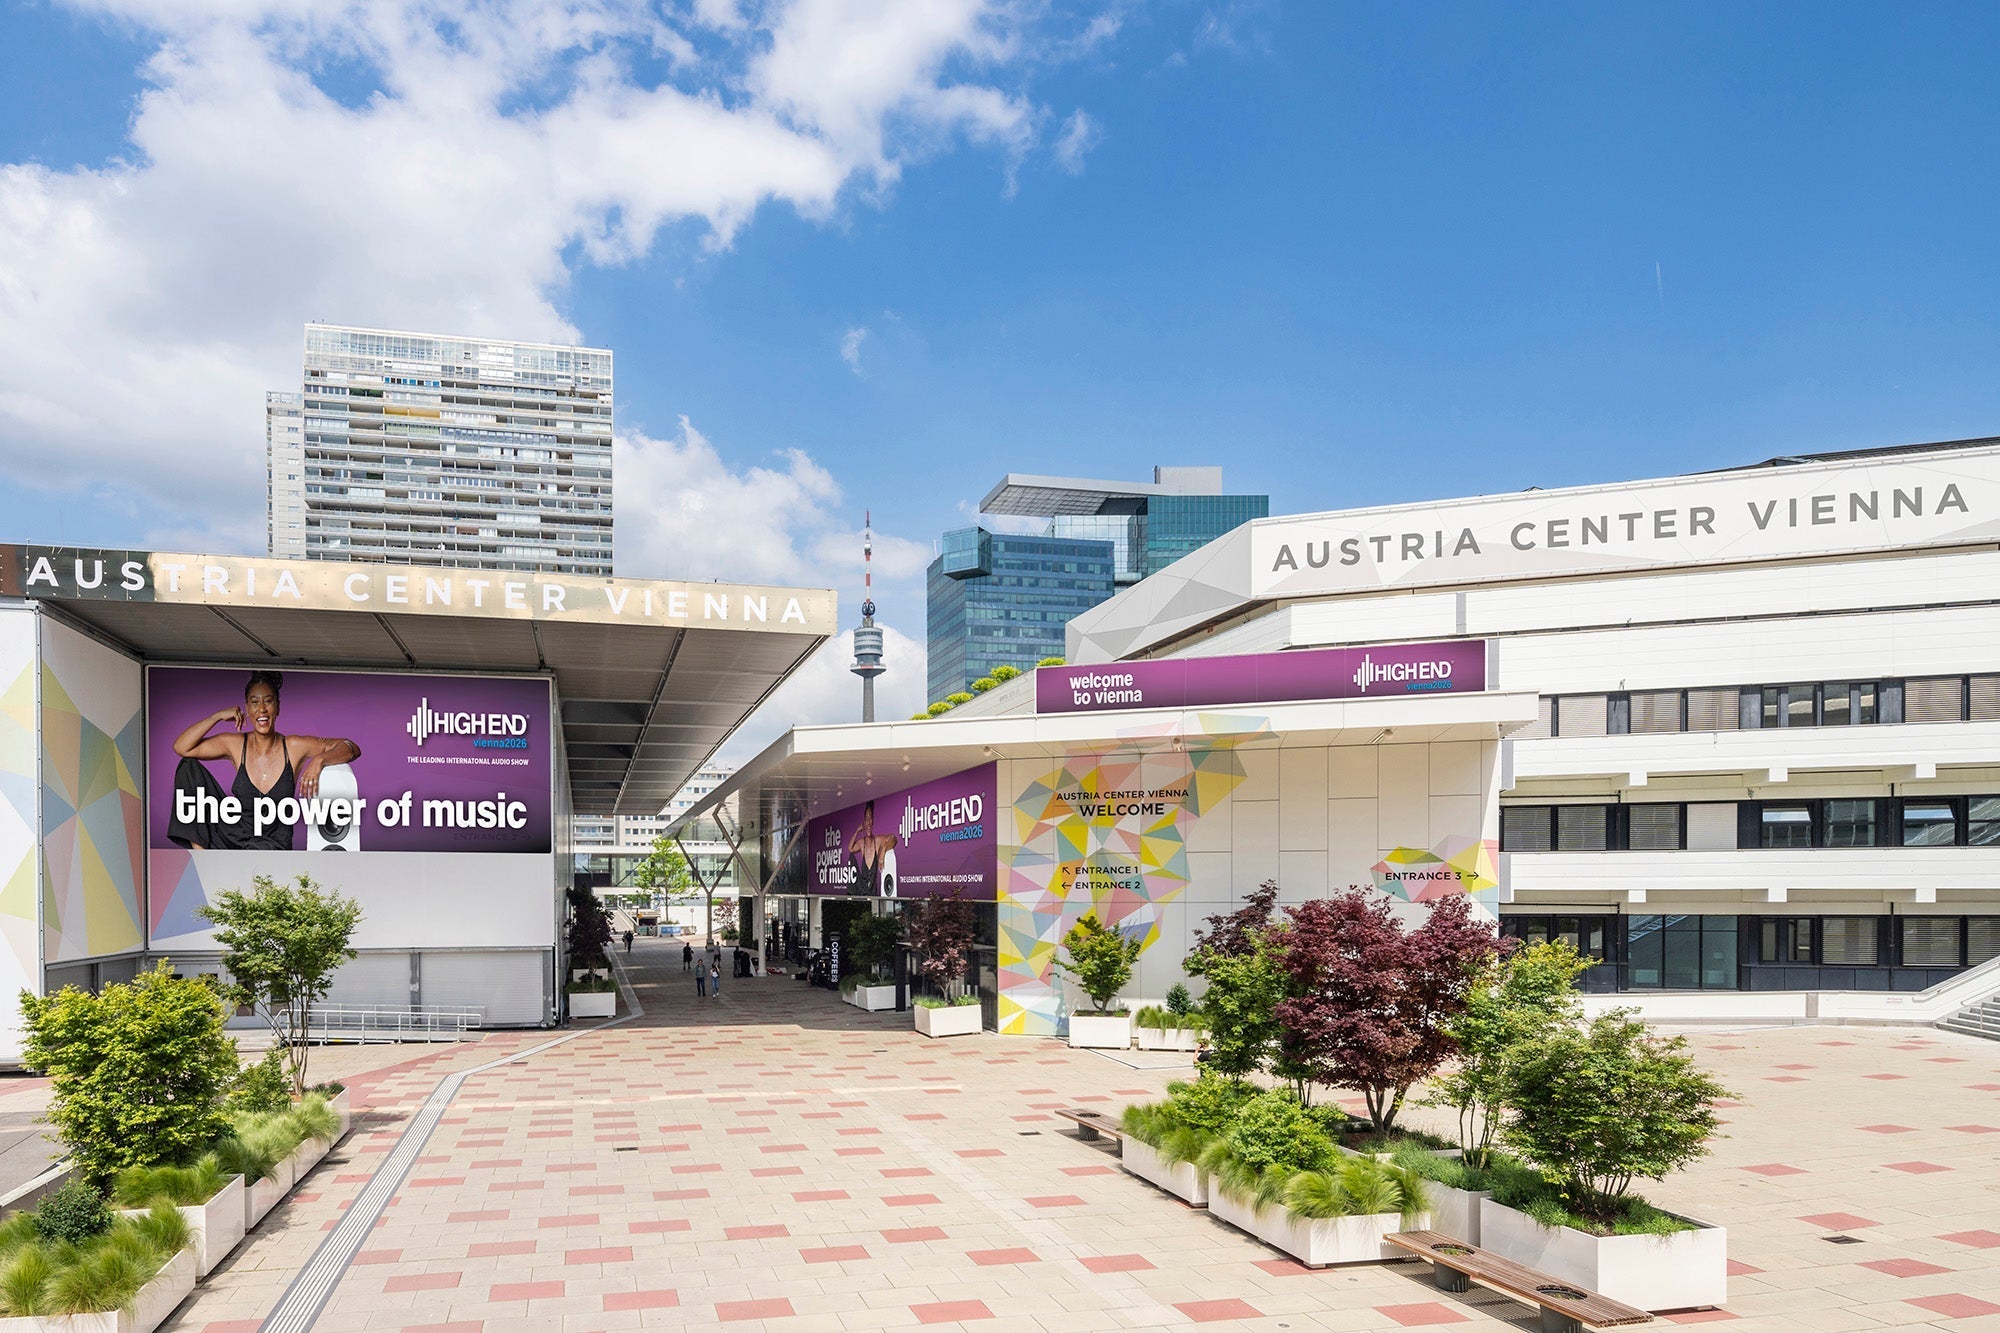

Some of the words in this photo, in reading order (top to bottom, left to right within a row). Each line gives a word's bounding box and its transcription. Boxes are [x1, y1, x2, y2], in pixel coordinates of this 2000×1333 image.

[1271, 526, 1481, 573] AUSTRIA
[1510, 506, 1715, 551] CENTER
[1747, 483, 1969, 530] VIENNA
[26, 556, 301, 599] AUSTRIA
[344, 573, 566, 611] CENTER
[604, 587, 807, 624] VIENNA
[1069, 672, 1133, 690] welcome
[1406, 680, 1452, 690] vienna2026
[1073, 690, 1091, 705] to
[1095, 688, 1142, 704] vienna
[473, 738, 528, 749] vienna2026
[419, 756, 445, 764] LEADING
[510, 758, 529, 766] SHOW
[1056, 792, 1100, 801] AUSTRIA
[1103, 790, 1145, 799] CENTER
[1147, 789, 1189, 798] VIENNA
[175, 787, 242, 825] the
[253, 797, 367, 837] power
[377, 790, 412, 827] of
[422, 792, 528, 829] music
[1079, 803, 1165, 816] WELCOME
[825, 826, 841, 848] the
[940, 824, 983, 842] vienna2026
[816, 848, 842, 873] power
[819, 863, 828, 884] of
[829, 860, 857, 884] music
[968, 874, 983, 882] SHOW
[1075, 866, 1131, 874] ENTRANCE
[1134, 866, 1138, 874] 1
[1385, 871, 1451, 881] ENTRANCE
[1455, 871, 1462, 880] 3
[1075, 881, 1131, 889] ENTRANCE
[1134, 881, 1140, 889] 2
[831, 941, 839, 974] COFFEE
